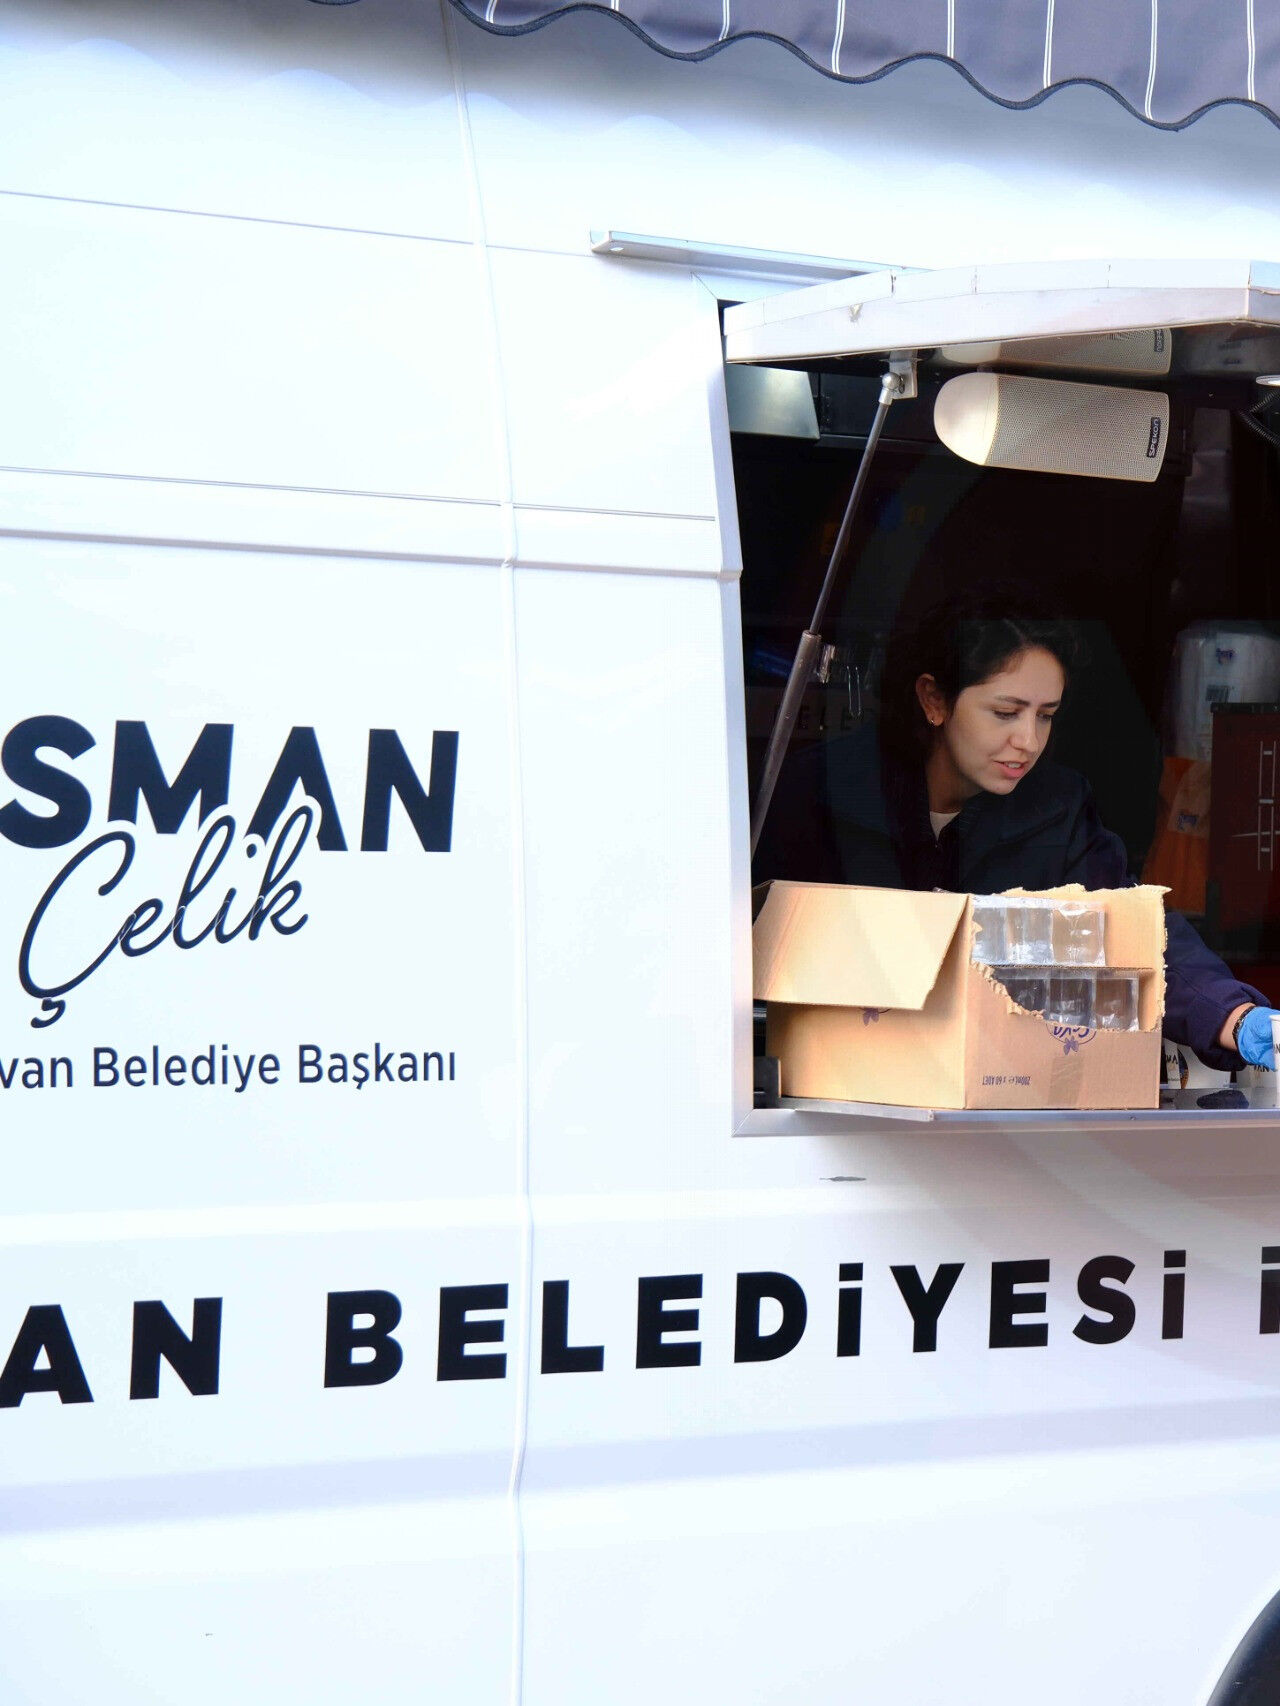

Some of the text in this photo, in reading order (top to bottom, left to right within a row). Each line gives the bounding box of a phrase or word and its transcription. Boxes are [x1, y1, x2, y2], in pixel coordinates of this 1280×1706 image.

[19, 804, 313, 1028] Çelik
[93, 1044, 280, 1094] Belediye
[298, 1042, 455, 1090] Başkanı
[0, 1297, 223, 1408] AN
